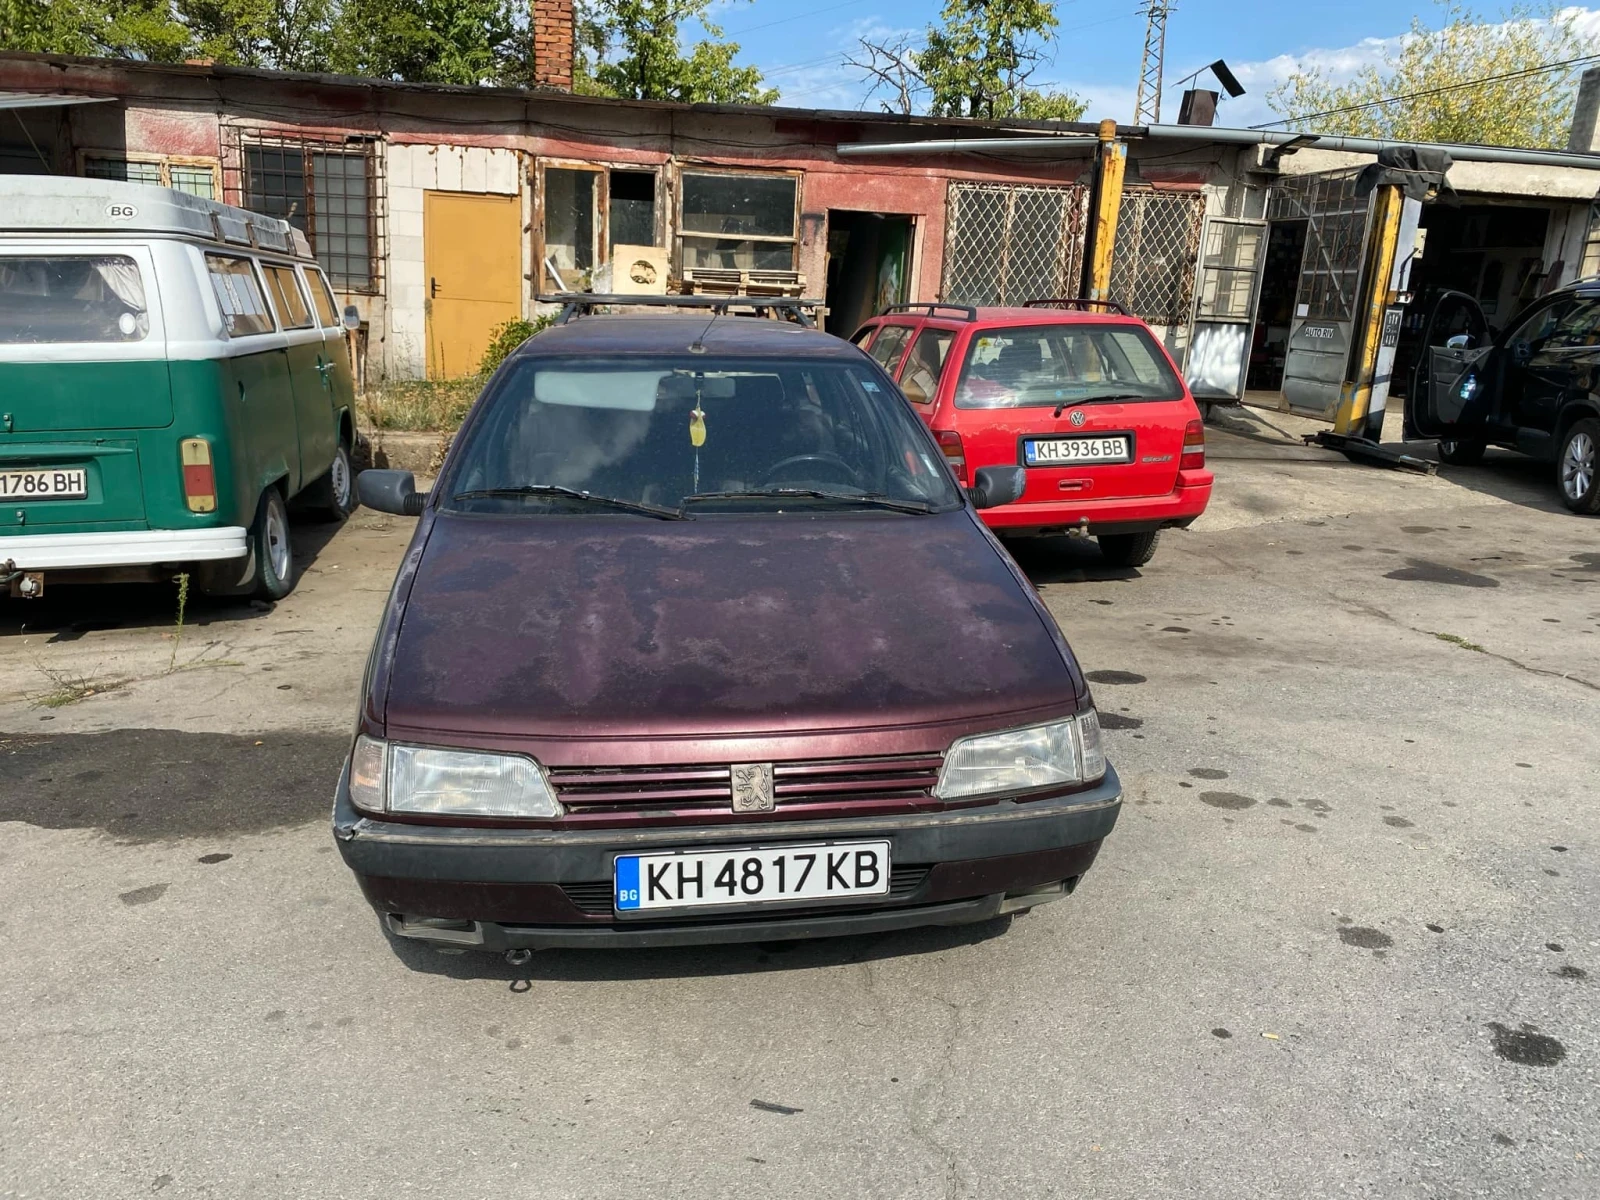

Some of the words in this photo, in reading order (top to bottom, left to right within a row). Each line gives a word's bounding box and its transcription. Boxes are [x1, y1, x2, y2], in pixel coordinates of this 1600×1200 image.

[110, 206, 134, 217] BG
[1305, 327, 1321, 337] AUTO
[1037, 442, 1059, 459] KH
[1061, 441, 1100, 457] 3936
[1102, 440, 1123, 456] BB
[0, 473, 49, 494] 1786
[53, 472, 81, 493] BH
[619, 889, 638, 902] BG
[648, 860, 704, 901] KH
[714, 853, 816, 896] 4817
[827, 850, 880, 890] KB
